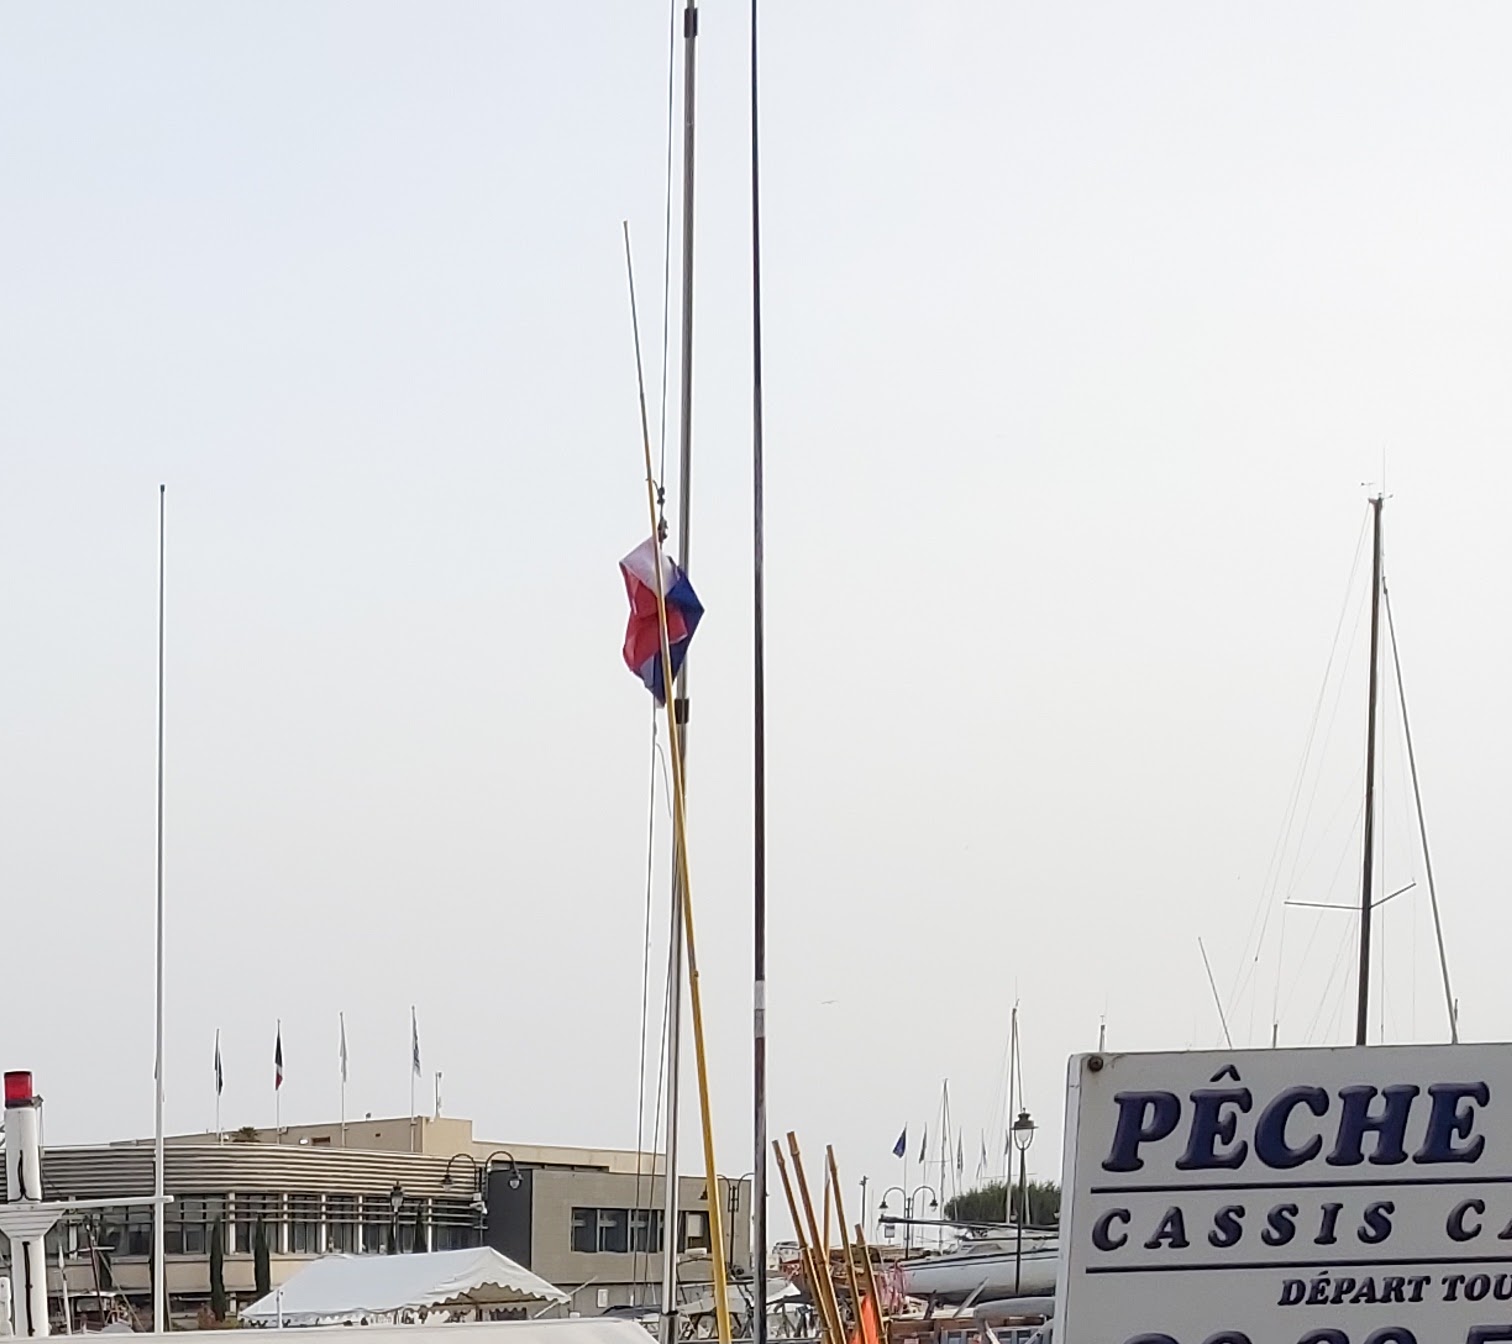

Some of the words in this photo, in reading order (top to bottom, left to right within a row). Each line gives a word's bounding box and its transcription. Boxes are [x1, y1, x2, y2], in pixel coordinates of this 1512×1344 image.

[1102, 1064, 1489, 1171] PÊCHE
[1092, 1201, 1395, 1251] CASSIS
[1278, 1271, 1430, 1306] DÉPART
